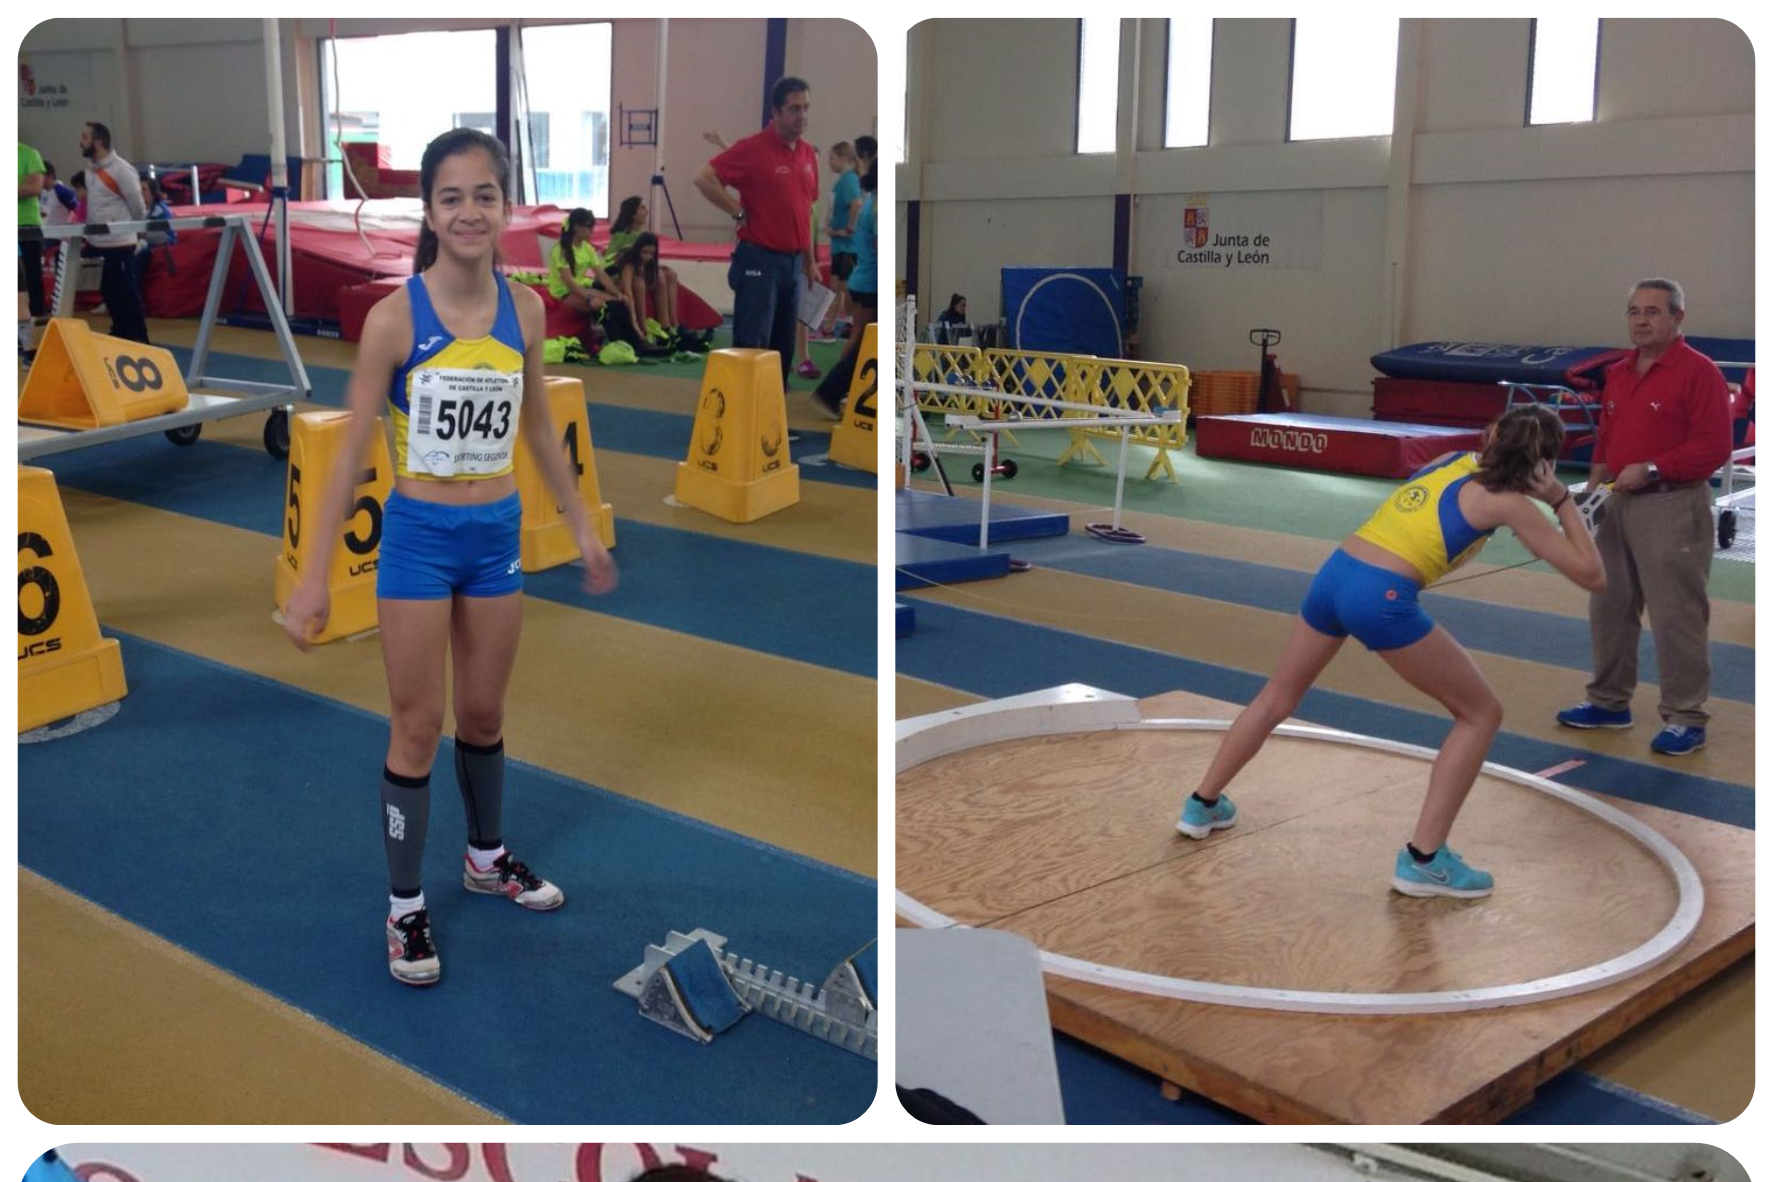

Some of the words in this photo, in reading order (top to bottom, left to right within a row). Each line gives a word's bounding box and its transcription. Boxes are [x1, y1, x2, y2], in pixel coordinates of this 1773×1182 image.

[1178, 250, 1222, 263] Castilla
[1225, 253, 1233, 267] y
[1237, 249, 1270, 264] León
[1213, 234, 1248, 247] Junta
[1253, 234, 1270, 247] de
[116, 355, 163, 392] 8
[855, 358, 878, 418] 2
[436, 400, 512, 440] 5043
[1251, 427, 1328, 453] MONDO
[288, 463, 301, 550] 5
[344, 467, 383, 555] 5
[18, 531, 60, 636] 6
